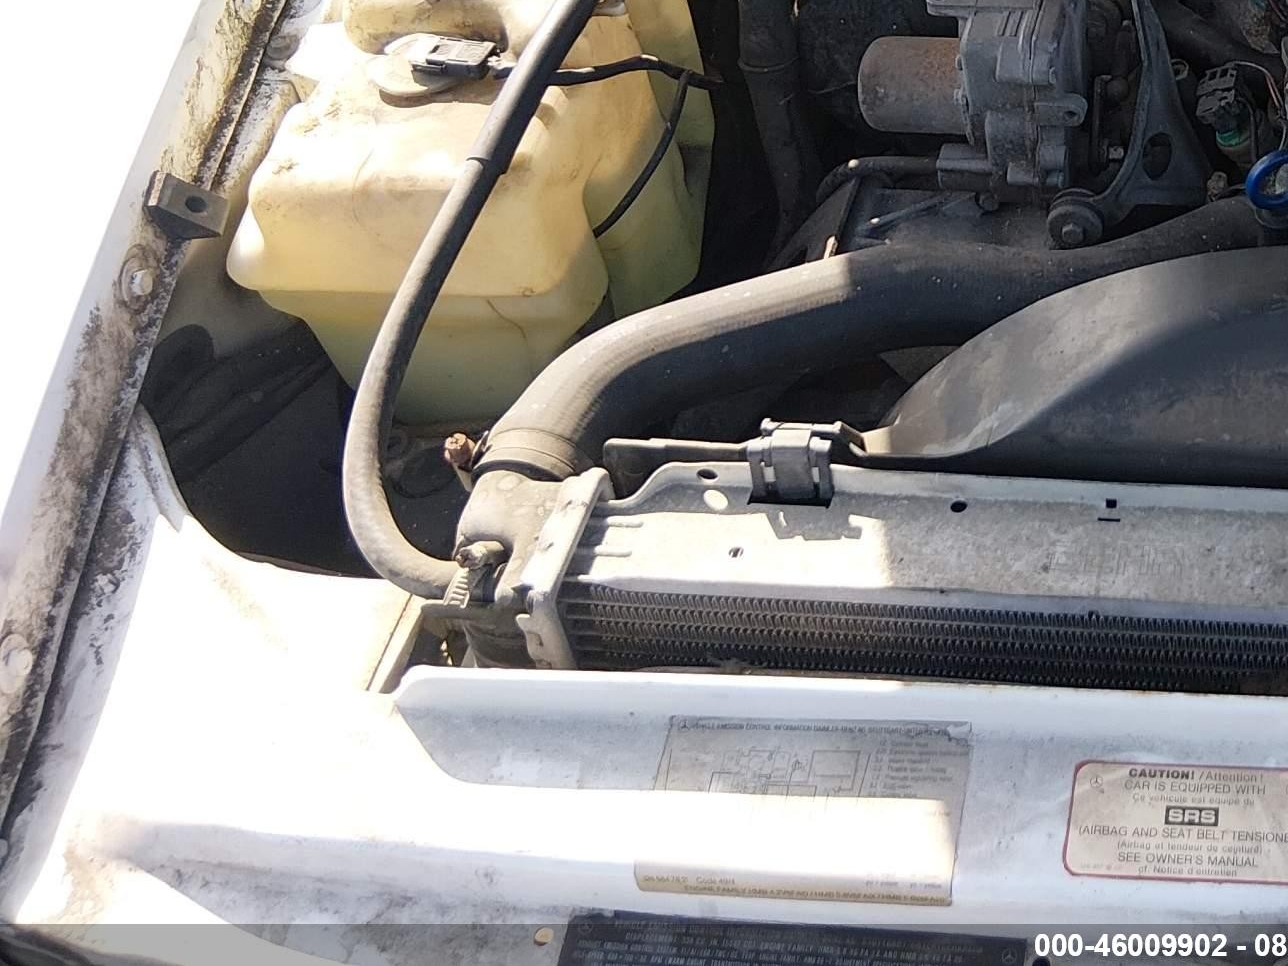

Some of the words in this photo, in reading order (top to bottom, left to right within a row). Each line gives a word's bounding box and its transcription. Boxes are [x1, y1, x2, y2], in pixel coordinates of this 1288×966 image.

[1128, 768, 1195, 780] CAUTION!
[1124, 779, 1151, 791] CAR
[1154, 781, 1166, 791] IS
[1170, 781, 1231, 794] EQUIPPED
[1235, 783, 1266, 795] WITH
[1166, 807, 1217, 825] SRS
[1079, 825, 1128, 837] (AIRBAG
[1132, 827, 1158, 838] AND
[1162, 827, 1193, 839] SEAT
[1196, 829, 1225, 840] BELT
[1118, 852, 1141, 863] SEE
[1207, 855, 1259, 868] MANUAL
